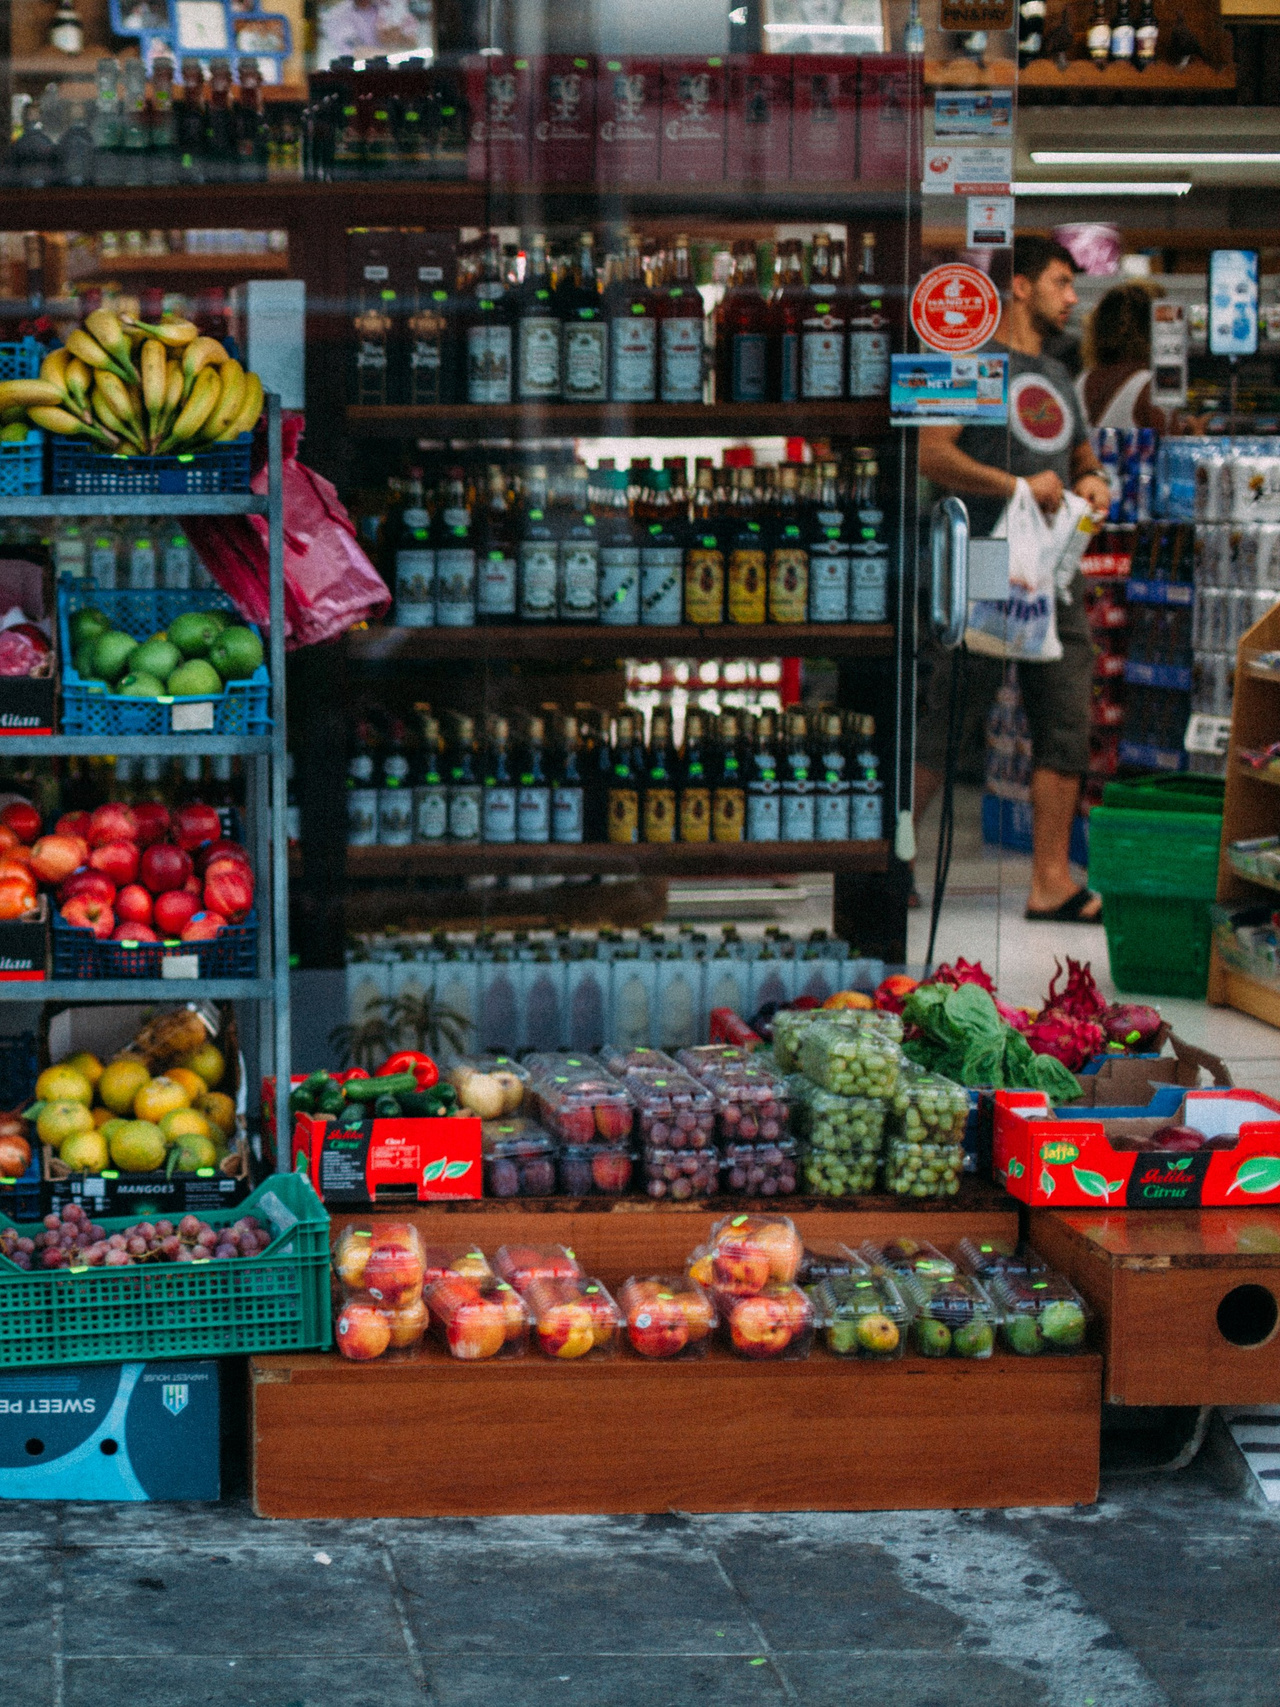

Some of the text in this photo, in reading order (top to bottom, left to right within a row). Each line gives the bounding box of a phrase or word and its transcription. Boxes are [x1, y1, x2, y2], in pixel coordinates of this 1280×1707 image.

[117, 1184, 175, 1194] MANGOES
[1143, 1184, 1188, 1198] Citrus
[27, 1398, 96, 1414] SWEET
